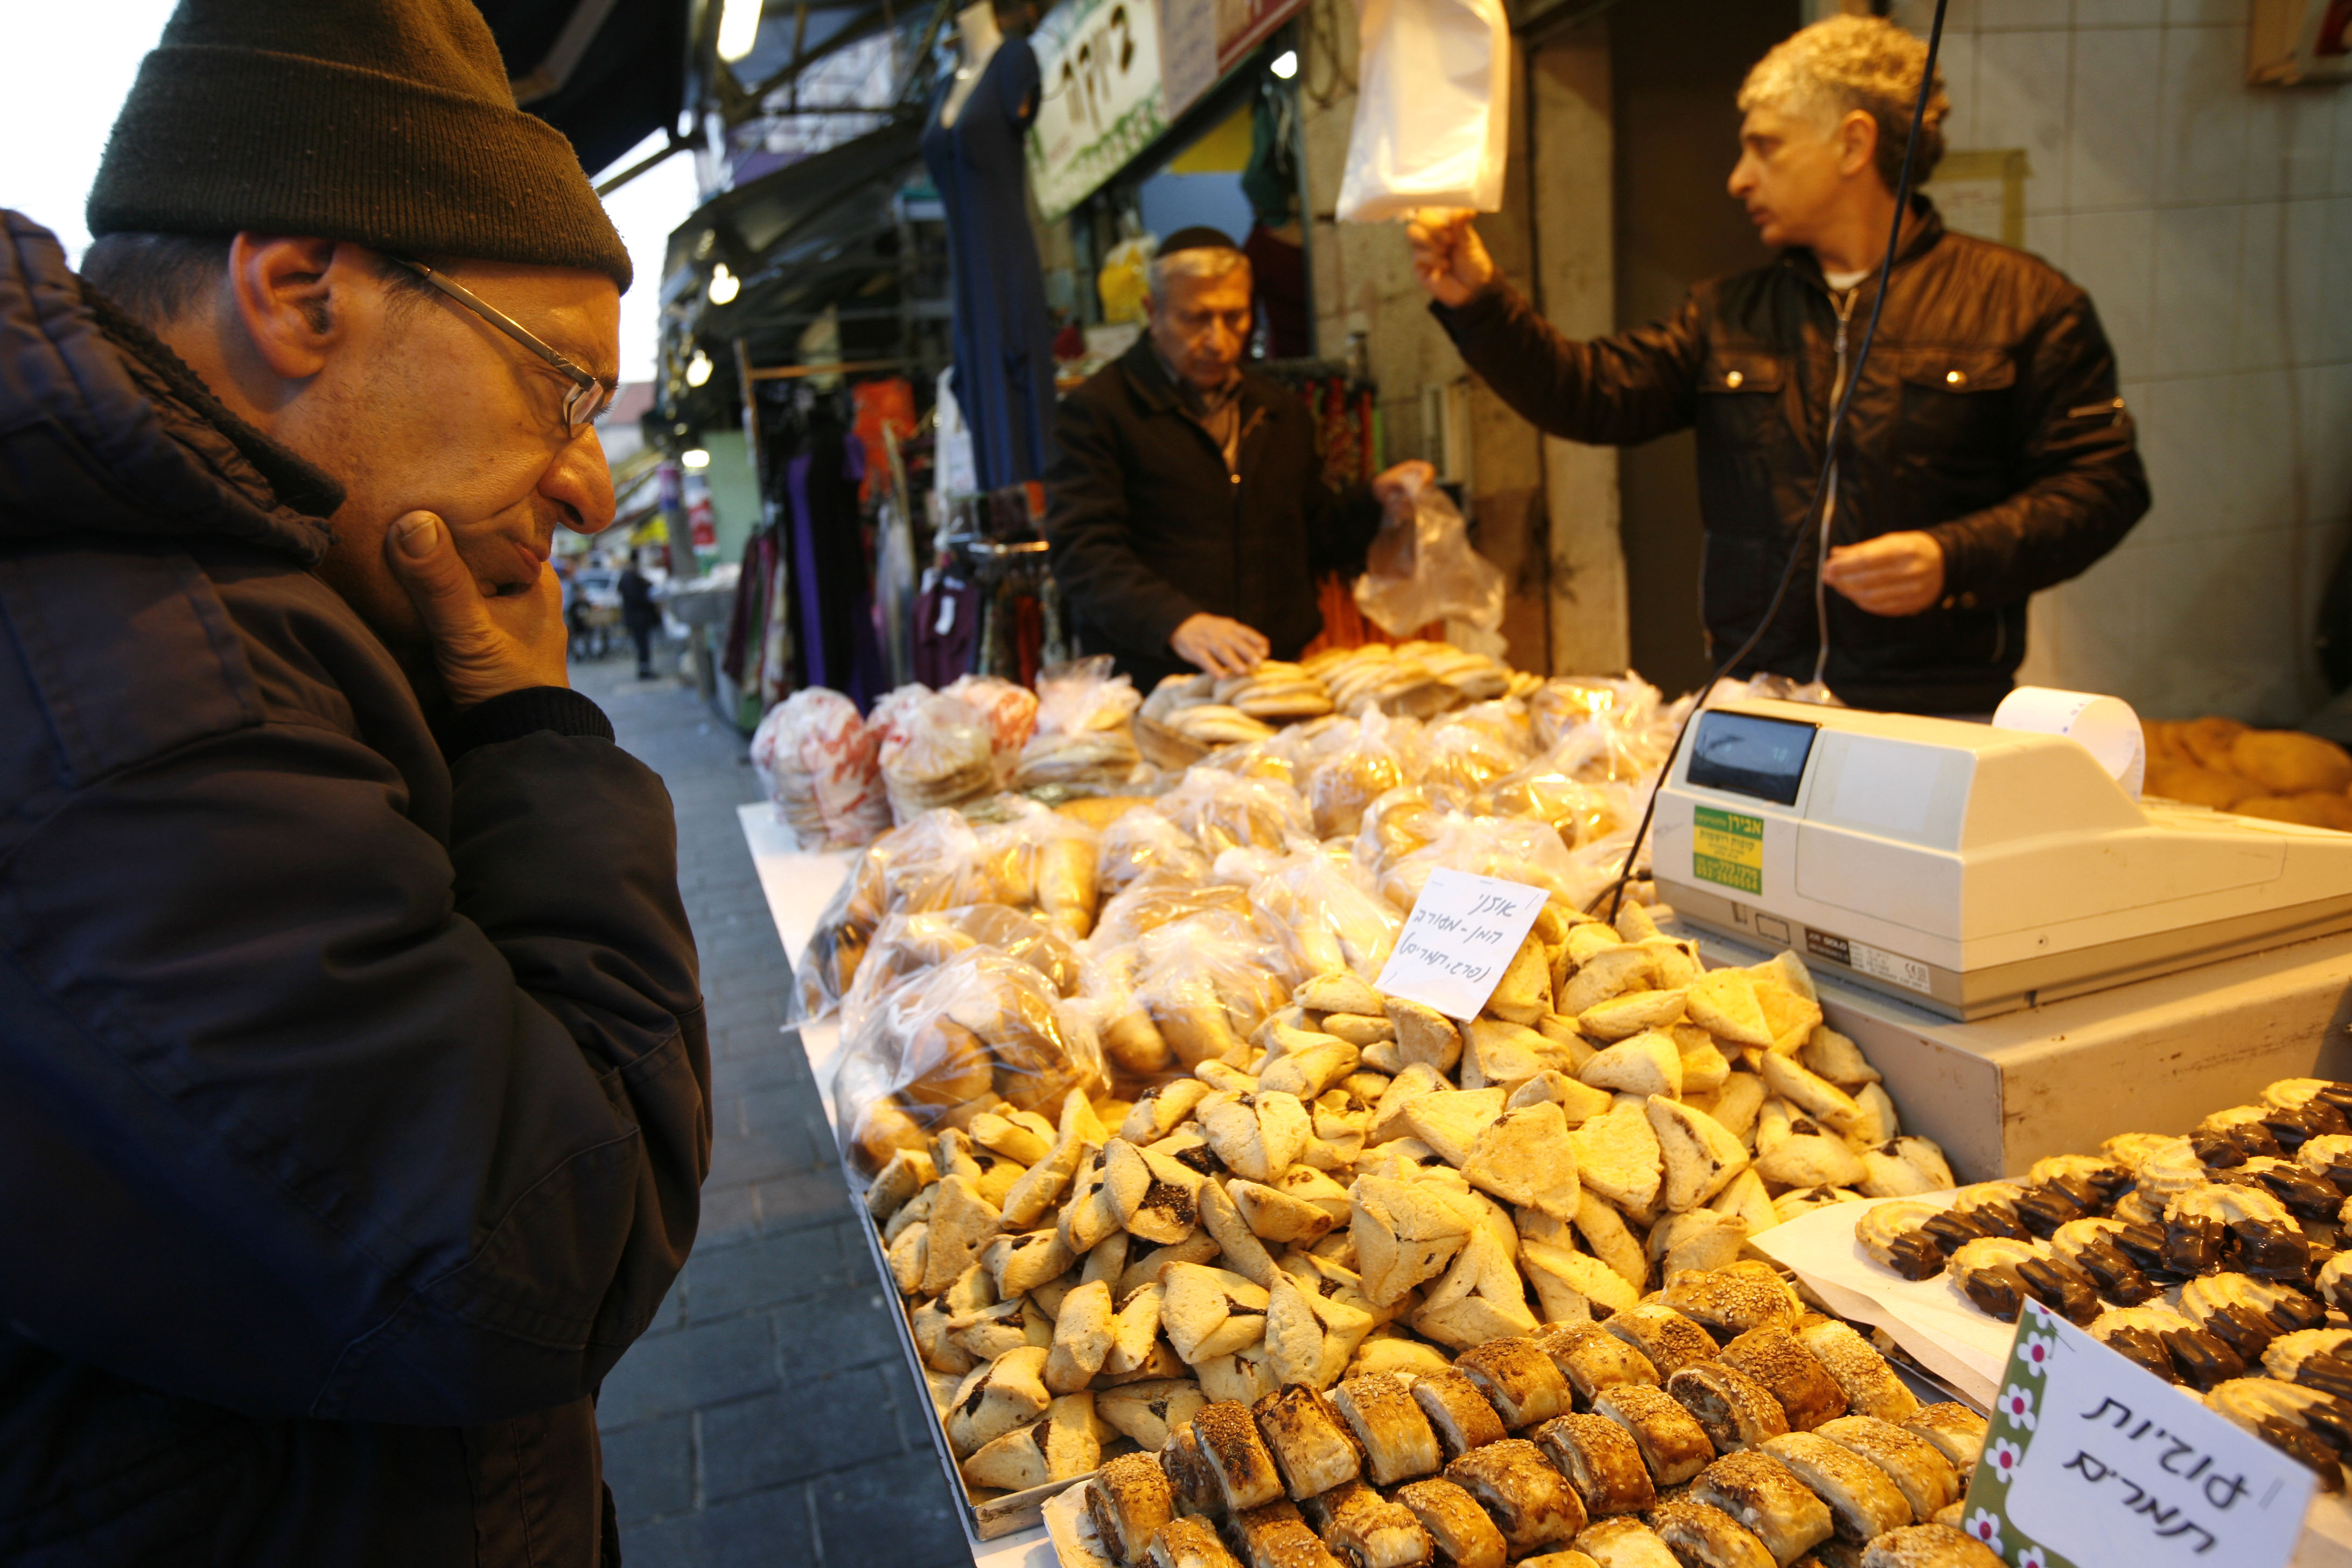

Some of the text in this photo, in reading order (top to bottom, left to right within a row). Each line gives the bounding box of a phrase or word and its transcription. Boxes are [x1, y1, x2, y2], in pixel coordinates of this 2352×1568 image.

[1467, 894, 1517, 917] אוזני
[2063, 1449, 2218, 1555] תמרים
[2080, 1396, 2251, 1512] עוגיות
